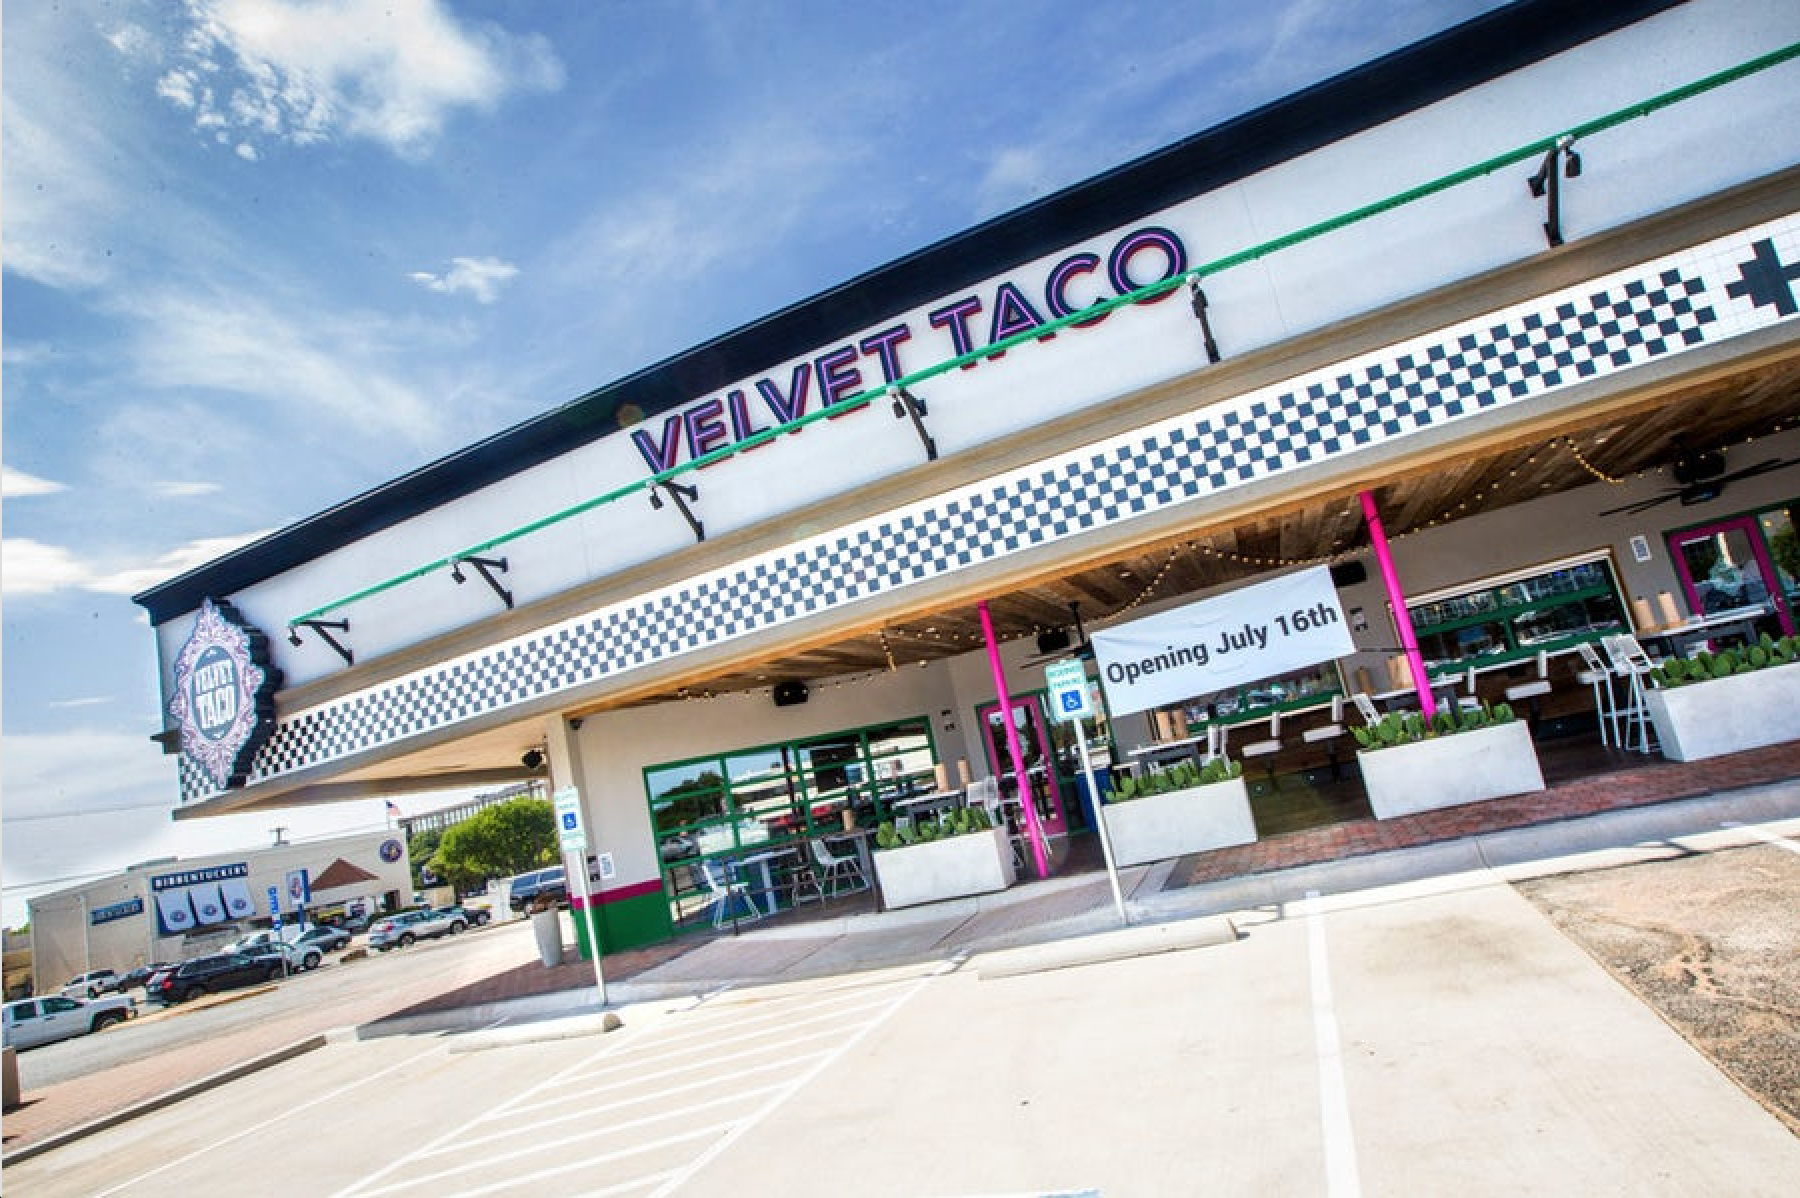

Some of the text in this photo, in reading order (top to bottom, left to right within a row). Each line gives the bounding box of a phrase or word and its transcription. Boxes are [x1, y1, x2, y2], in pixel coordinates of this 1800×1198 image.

[631, 226, 1187, 474] VELVET TACO
[1107, 602, 1338, 684] Opening July 16th
